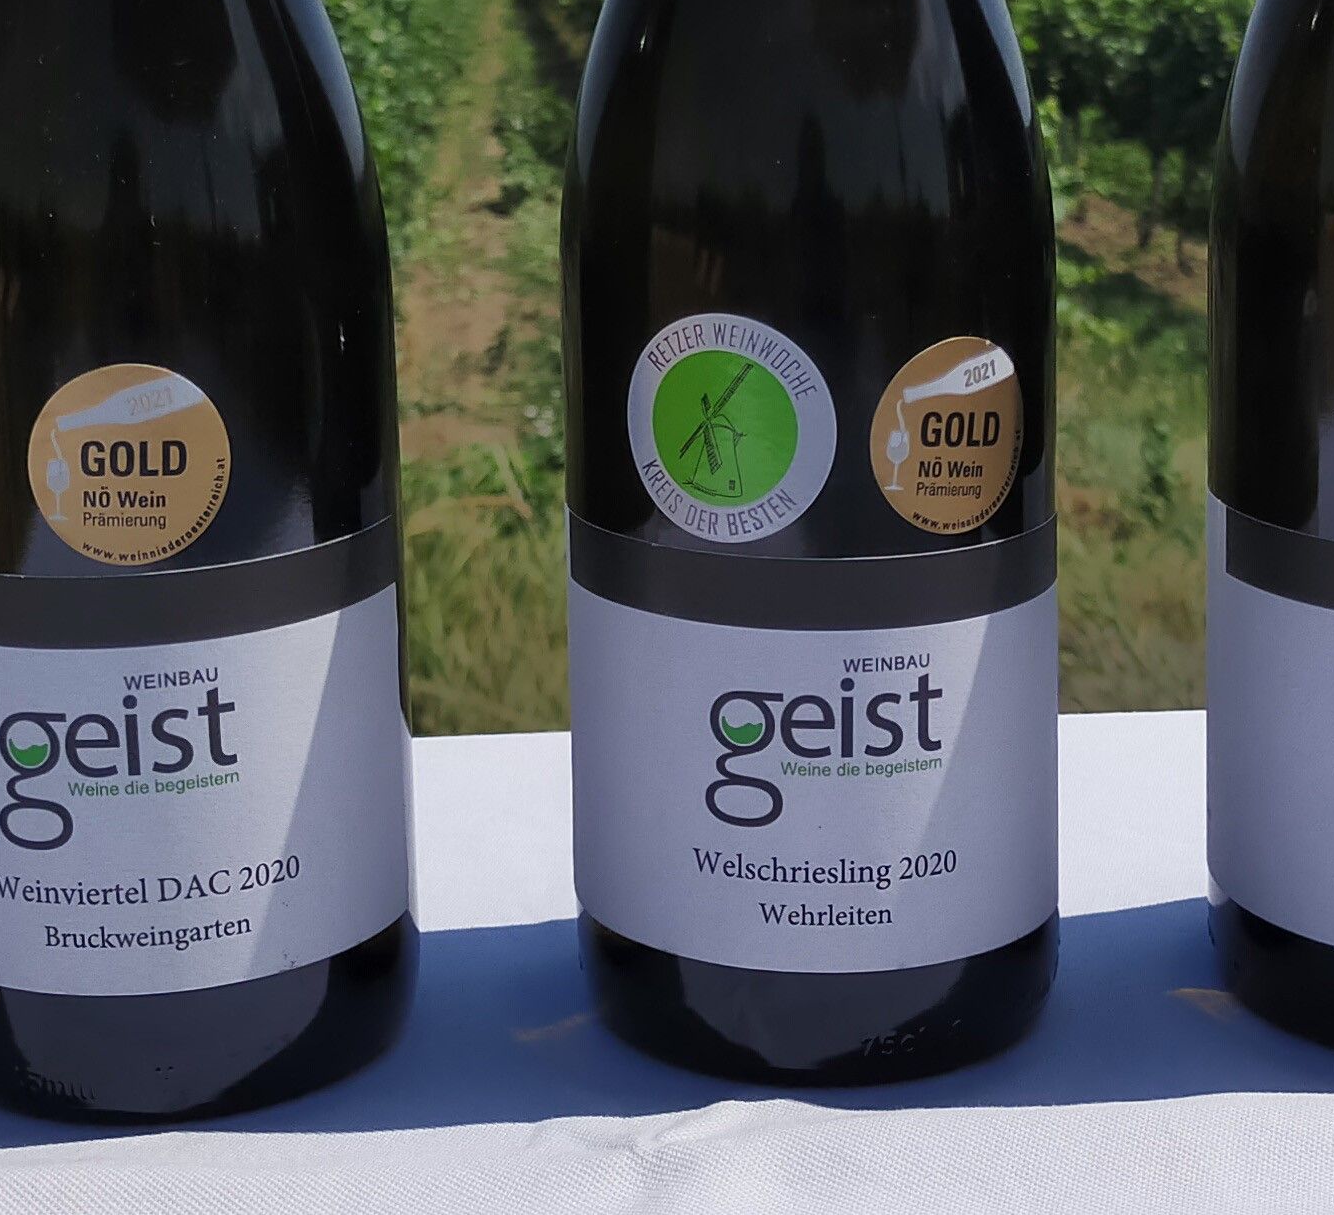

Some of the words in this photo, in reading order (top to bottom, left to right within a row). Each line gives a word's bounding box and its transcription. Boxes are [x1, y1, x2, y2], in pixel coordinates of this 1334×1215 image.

[648, 323, 706, 373] RETZER
[713, 323, 818, 401] WEINWOCHE
[963, 359, 997, 388] 2021
[124, 386, 174, 417] 2021
[920, 411, 1001, 448] GOLD
[80, 440, 188, 477] GOLD
[918, 456, 943, 478] NÖ
[948, 460, 983, 478] Wein
[82, 486, 111, 508] NÖ
[117, 490, 166, 508] Wein
[643, 459, 684, 515] KREIS
[685, 504, 719, 536] DER
[727, 488, 798, 537] BESTEN
[916, 481, 982, 500] Prämierung
[82, 512, 167, 530] Prämierung
[843, 653, 931, 673] WEINBAU
[123, 667, 219, 691] WEINBAU
[705, 673, 943, 827] geist
[781, 761, 831, 776] Weine
[837, 761, 861, 776] die
[865, 756, 943, 778] begeistern
[67, 781, 119, 797] Weine
[124, 781, 150, 796] die
[155, 770, 240, 796] begeistern
[157, 869, 232, 902] DAC
[239, 855, 301, 891] 2020
[692, 847, 893, 890] Welschriesling
[899, 849, 957, 881] 2020
[758, 902, 893, 926] Wehrleiten
[44, 917, 252, 951] Bruckweingarten
